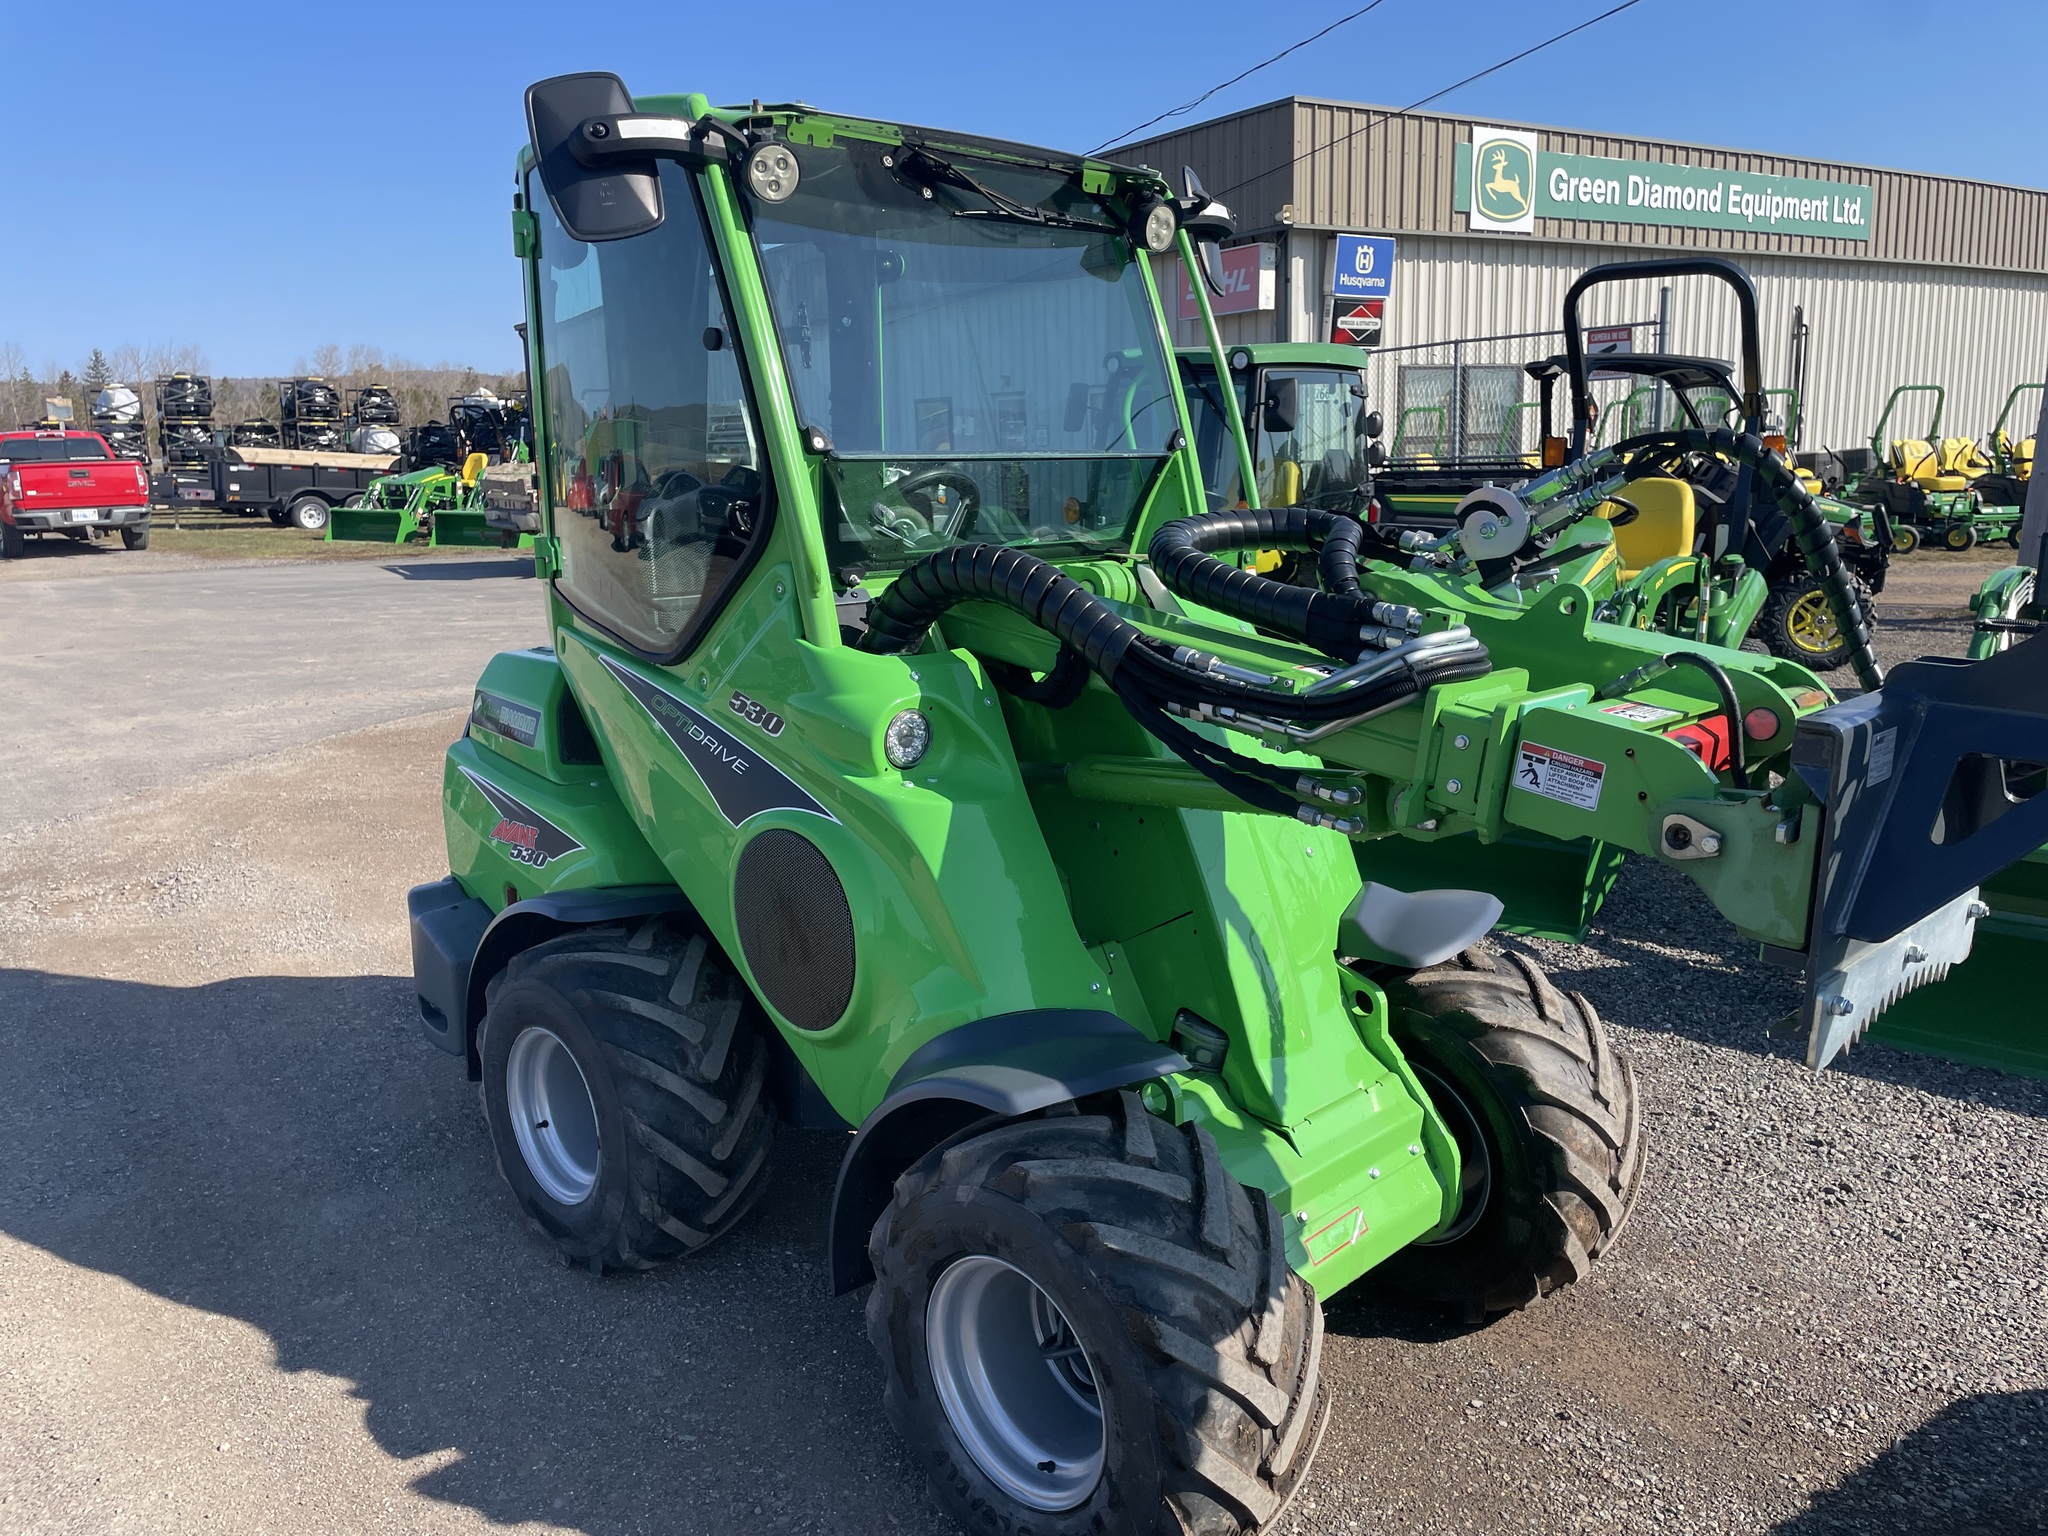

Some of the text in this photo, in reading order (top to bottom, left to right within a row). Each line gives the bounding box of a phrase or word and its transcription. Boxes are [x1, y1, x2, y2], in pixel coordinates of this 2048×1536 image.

[1549, 167, 1865, 226] Green Diamond Equipment Ltd.
[1340, 273, 1385, 289] Husqvarna
[728, 690, 785, 737] 530
[651, 694, 750, 775] OPTIDRIVE
[1551, 760, 1595, 776] CRUSH HAZARD
[1552, 752, 1584, 767] DANGER
[1547, 777, 1584, 791] ATTACHMENT
[1548, 771, 1567, 780] LIFTED
[1568, 777, 1586, 786] BOOM
[1550, 766, 1598, 784] KEEP AWAY FROM
[489, 817, 540, 849] AVANT
[509, 845, 550, 869] 530
